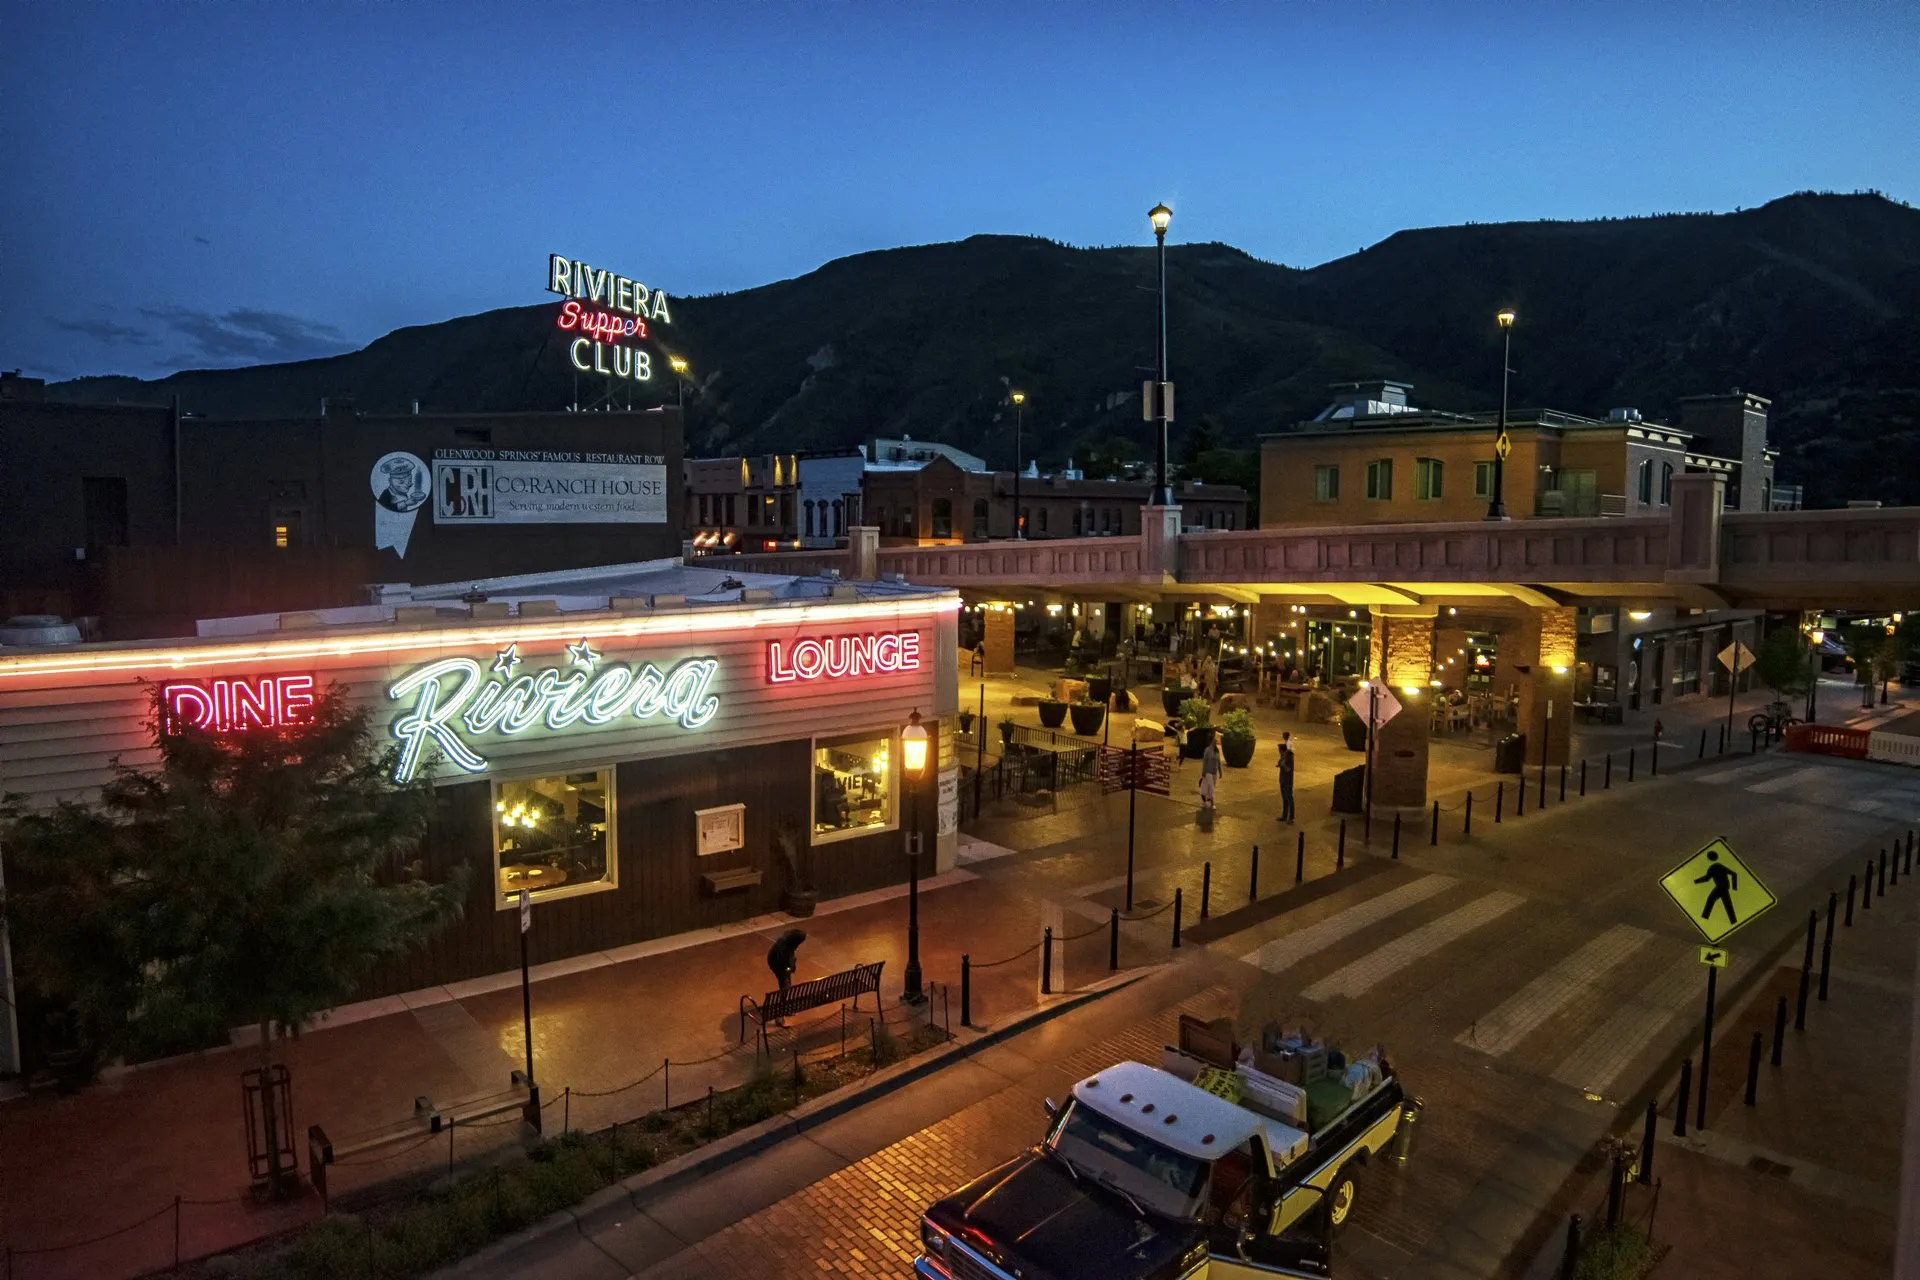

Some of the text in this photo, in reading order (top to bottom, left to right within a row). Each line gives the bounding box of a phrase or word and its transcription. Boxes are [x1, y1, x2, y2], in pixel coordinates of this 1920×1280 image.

[551, 254, 671, 324] RIVIERA
[558, 301, 648, 343] Supper
[570, 338, 652, 381] CLUB
[435, 448, 495, 460] GLENWOOD
[543, 451, 580, 462] FAMOUS
[585, 453, 642, 464] RESTAURANT
[644, 454, 665, 465] ROW
[509, 500, 543, 512] Serving
[546, 500, 580, 511] modern
[581, 502, 614, 512] western
[601, 480, 662, 496] HOUSE
[769, 630, 921, 683] LOUNGE
[163, 675, 316, 737] DINE
[389, 640, 719, 784] Riviera
